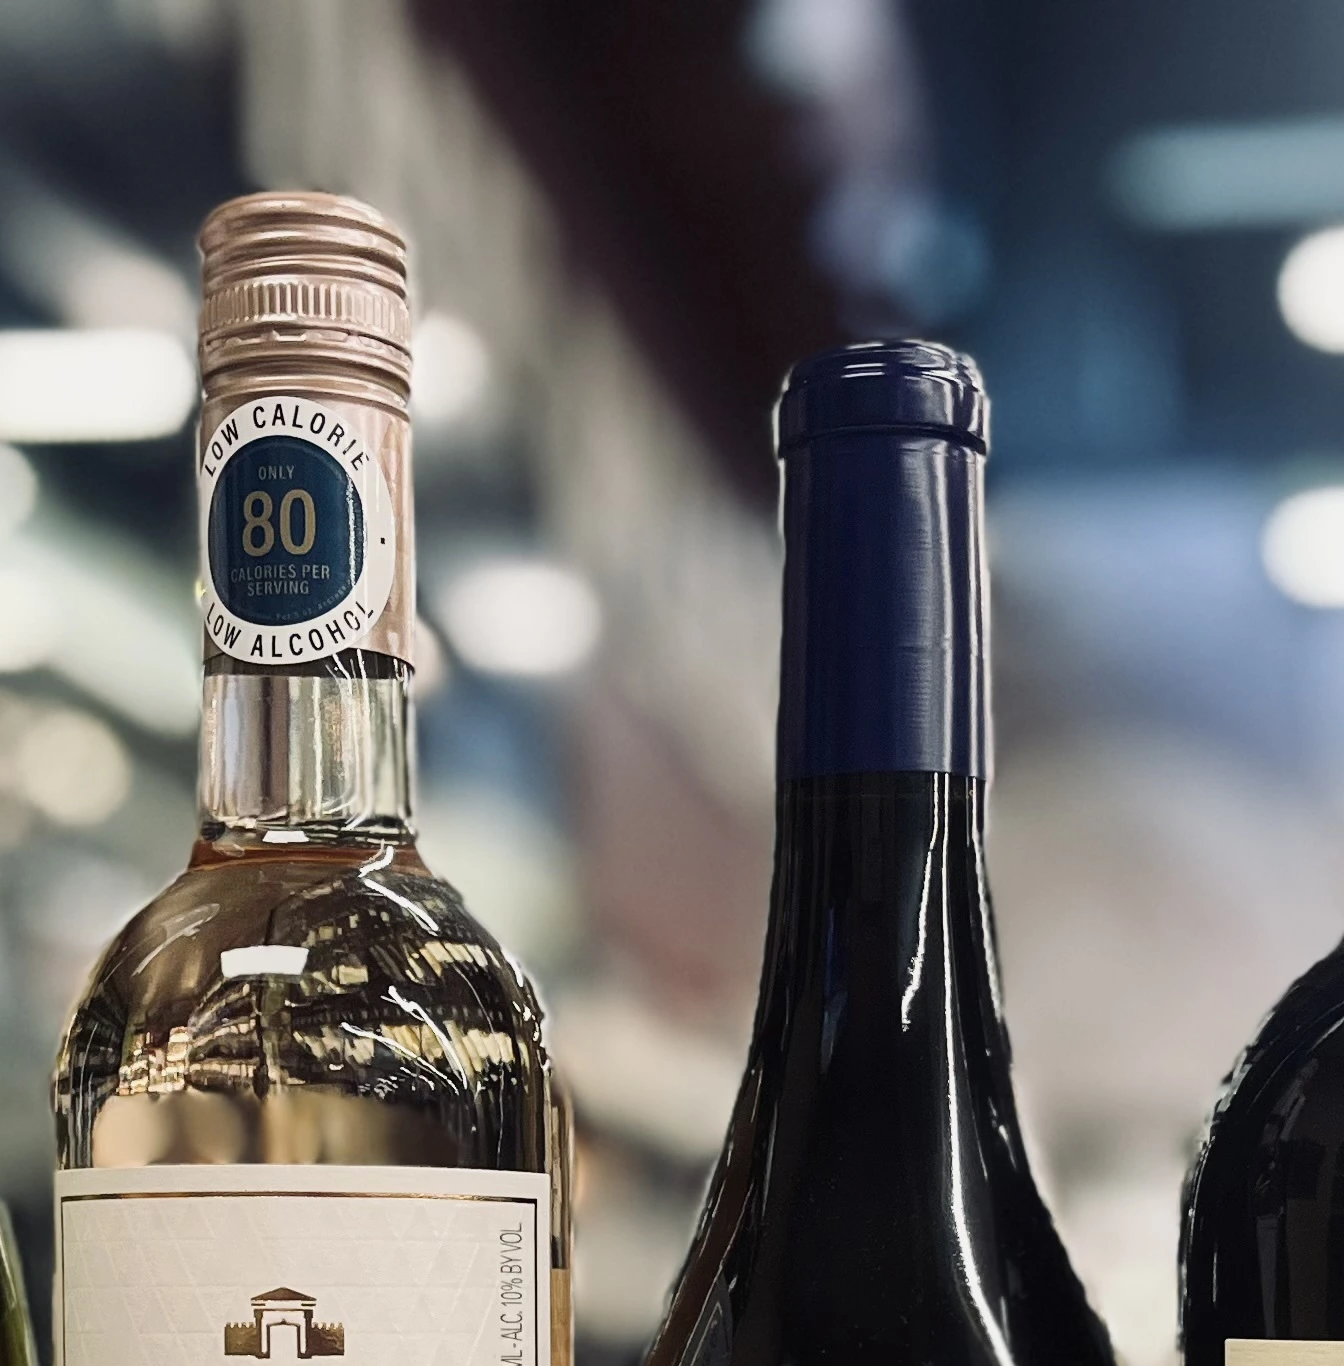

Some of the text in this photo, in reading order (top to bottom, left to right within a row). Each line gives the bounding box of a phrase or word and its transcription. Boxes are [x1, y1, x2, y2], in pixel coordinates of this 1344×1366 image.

[204, 403, 370, 477] LOW CALORIE
[258, 465, 295, 481] ONLY
[242, 488, 317, 557] 80
[230, 564, 330, 584] CALORIES PER
[247, 580, 310, 598] SERVING
[206, 601, 242, 649] LOW
[250, 601, 374, 658] ALCOHOL
[500, 1255, 522, 1274] BY
[500, 1277, 523, 1306] 10%
[500, 1310, 523, 1341] ALC.
